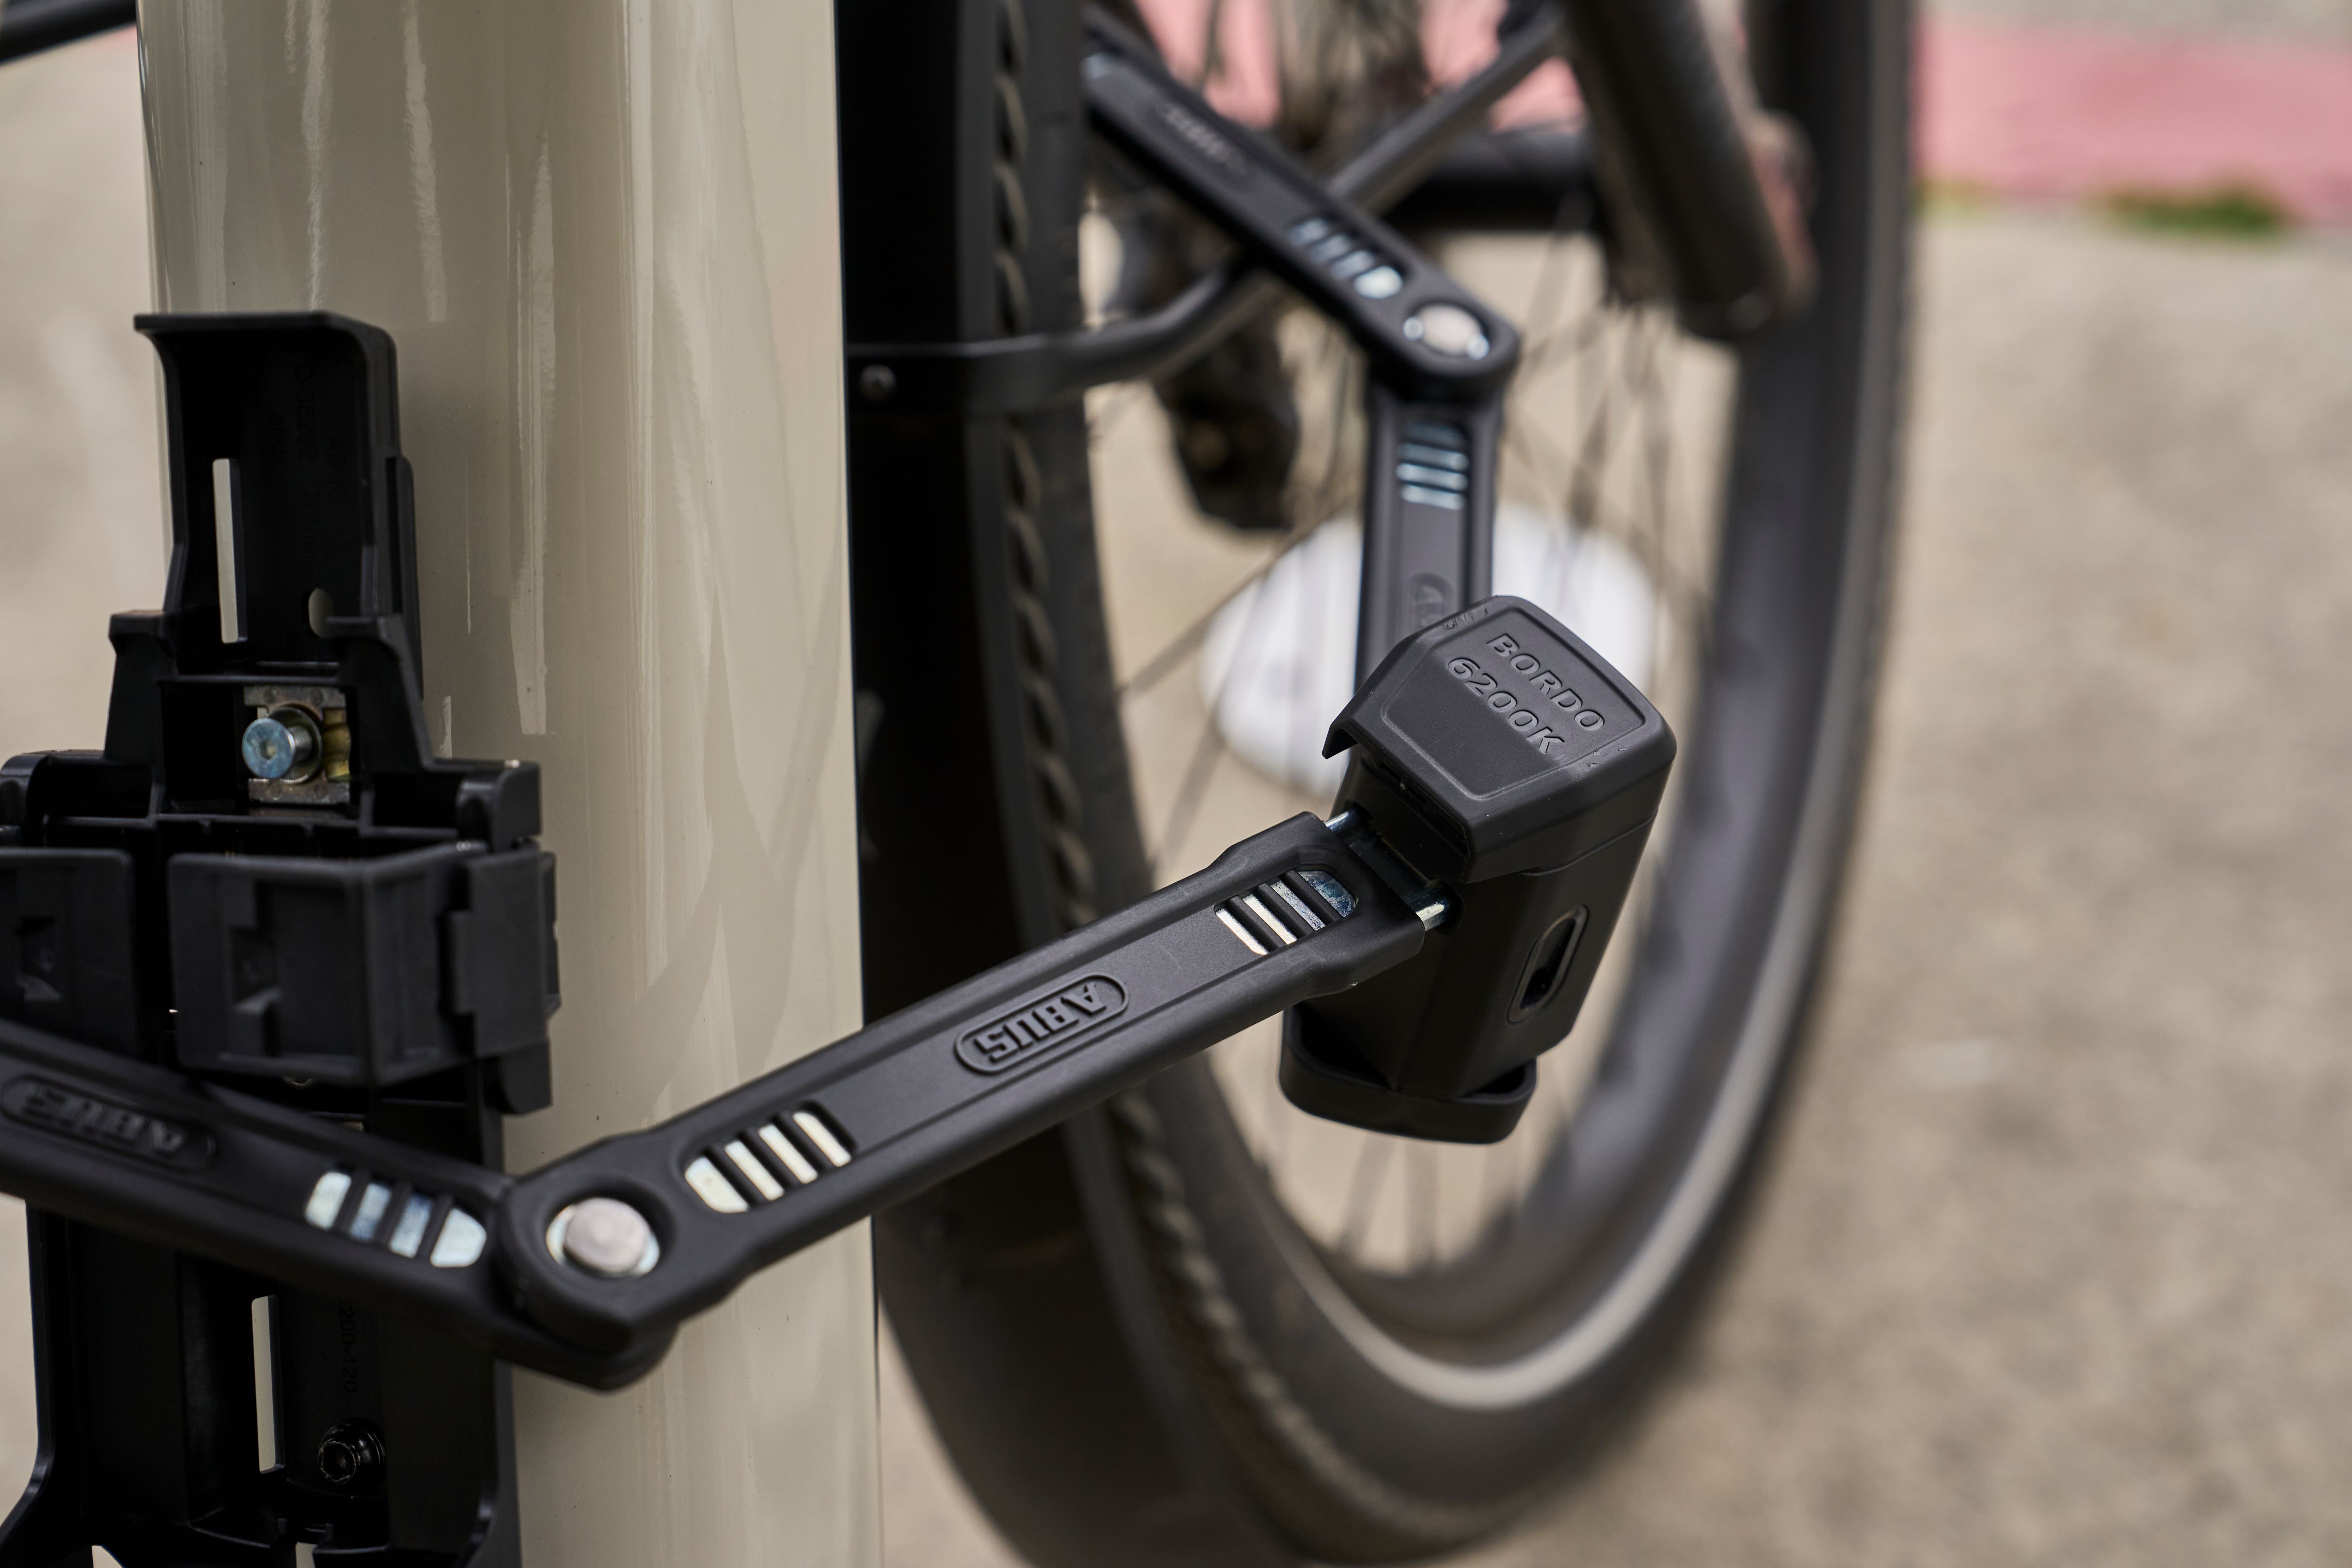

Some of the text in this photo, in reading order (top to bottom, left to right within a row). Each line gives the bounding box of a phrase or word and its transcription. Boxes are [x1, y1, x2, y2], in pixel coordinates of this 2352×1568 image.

[1447, 657, 1565, 754] 6200K
[1486, 633, 1605, 731] BORDO
[974, 983, 1107, 1063] ABUS
